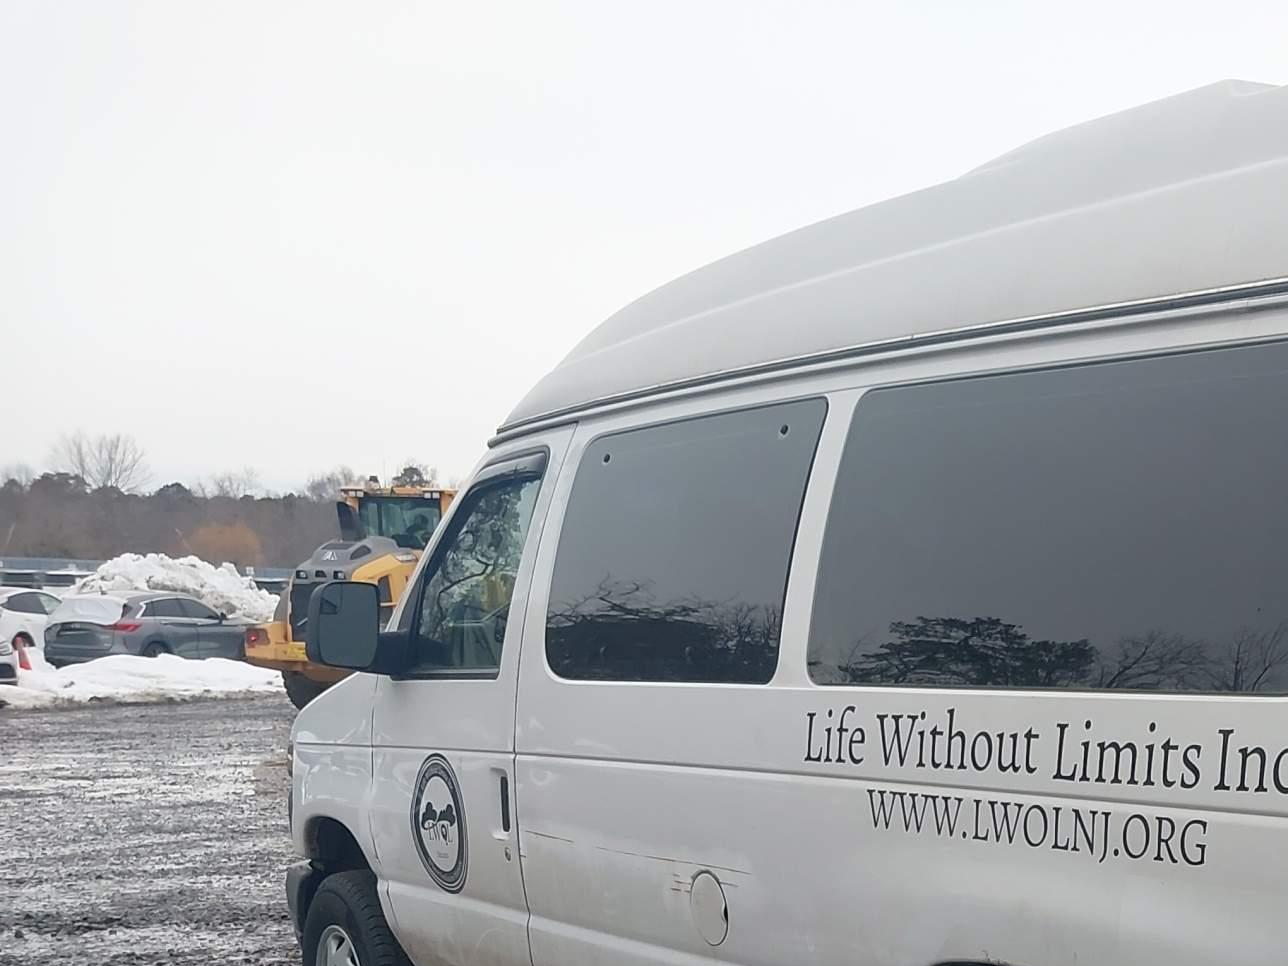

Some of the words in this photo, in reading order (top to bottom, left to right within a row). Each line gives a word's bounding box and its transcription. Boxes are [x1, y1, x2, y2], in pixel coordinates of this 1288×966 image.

[804, 705, 866, 765] Life
[876, 707, 1040, 775] Without
[1052, 719, 1202, 789] Limits
[866, 788, 1209, 866] WWW.LWOLNJ.ORG
